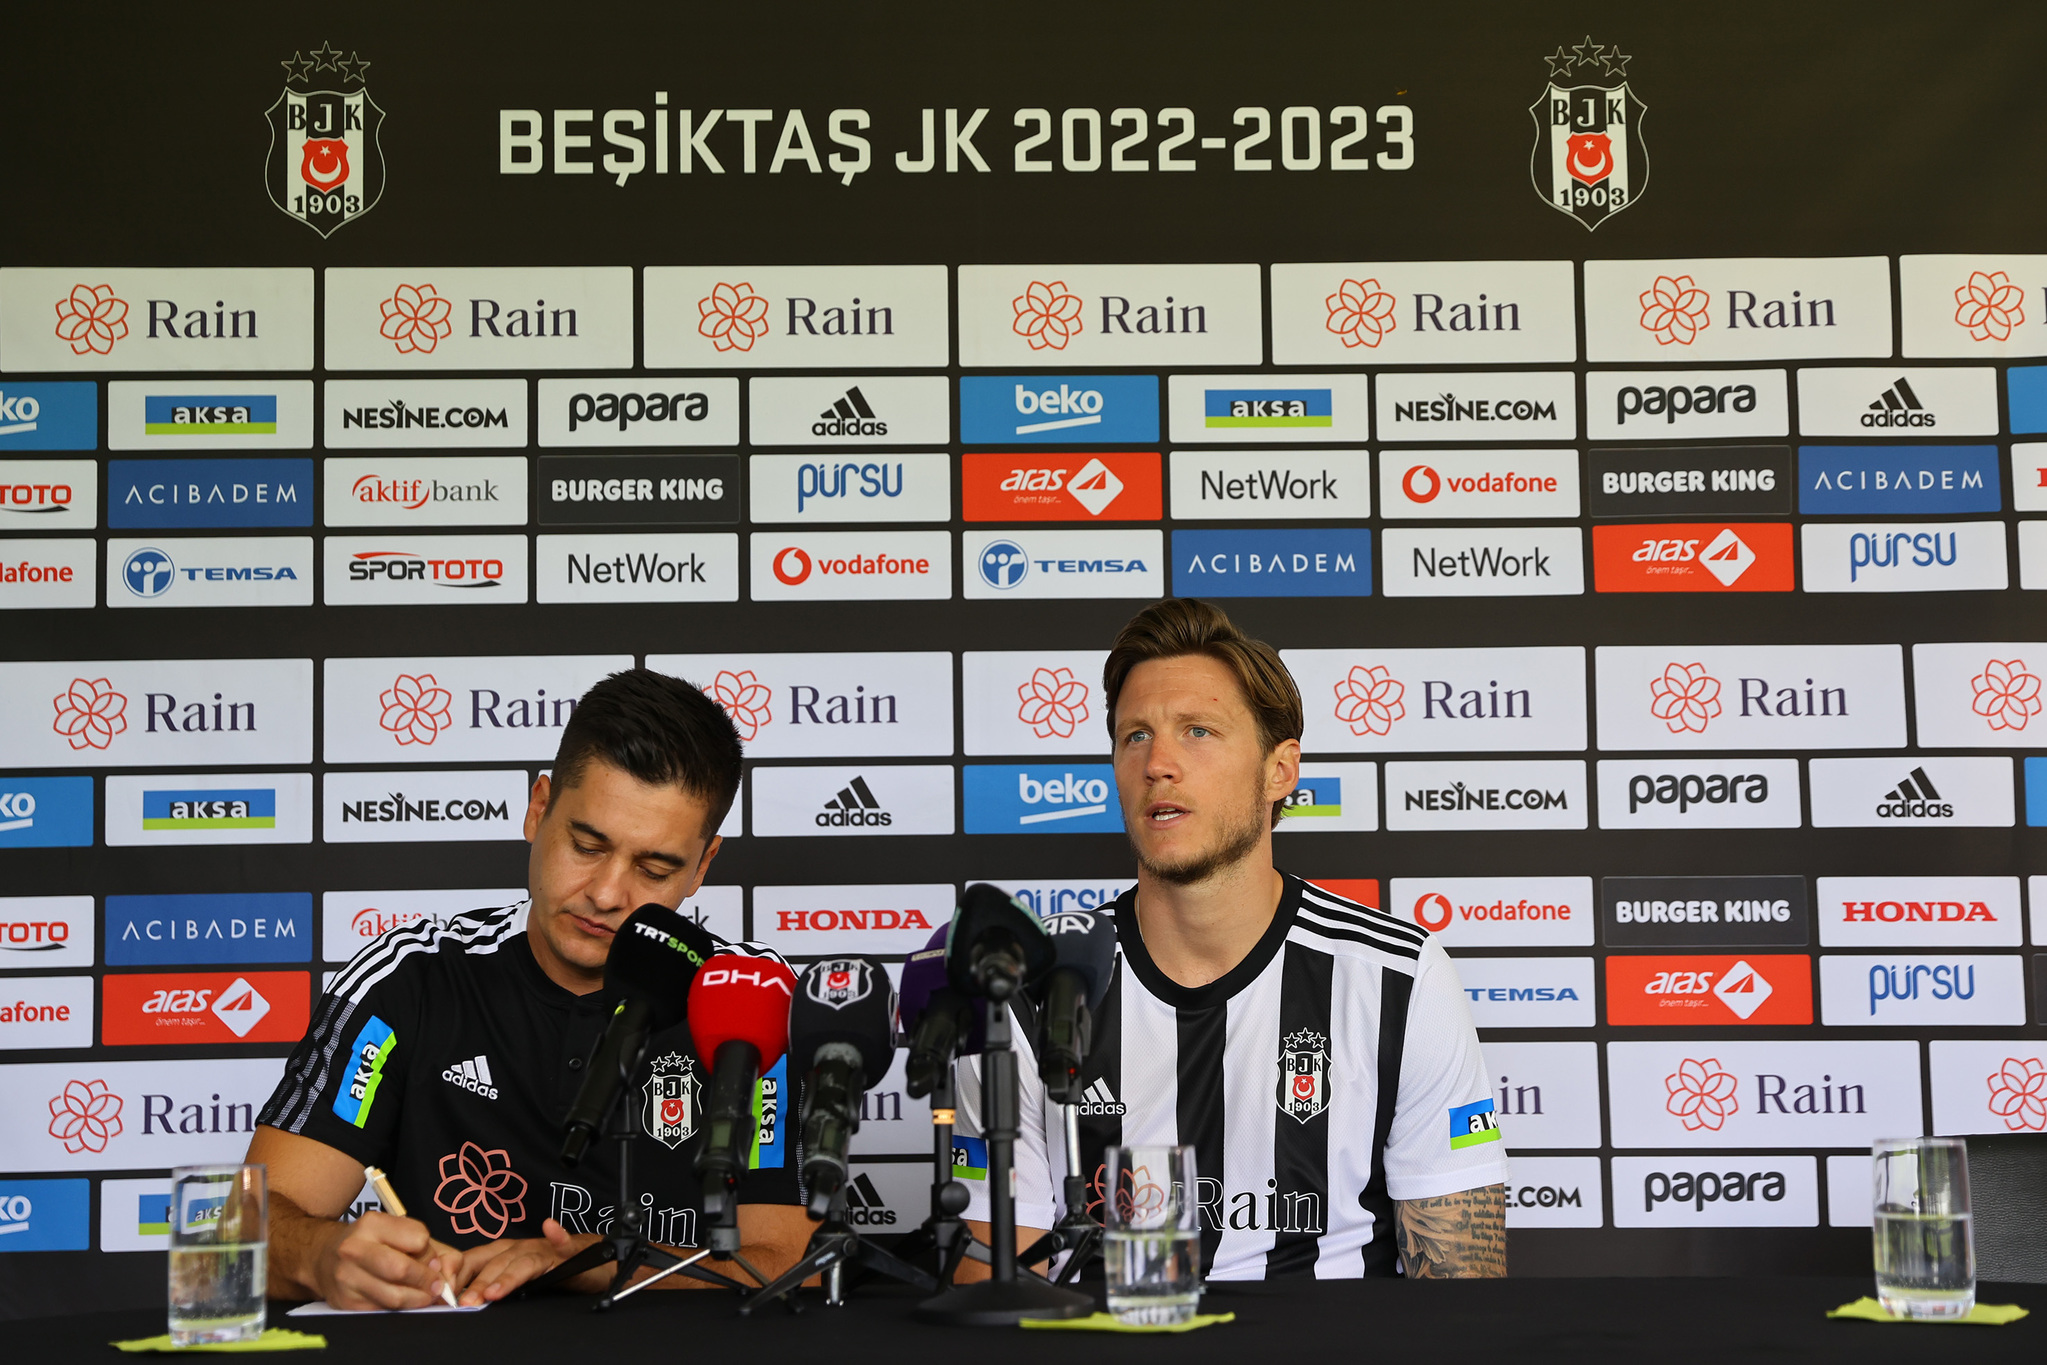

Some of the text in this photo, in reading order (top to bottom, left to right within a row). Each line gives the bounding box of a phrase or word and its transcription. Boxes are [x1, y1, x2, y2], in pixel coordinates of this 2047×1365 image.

[500, 92, 1414, 187] BEŞİKTAŞ JK 2022-2023
[293, 194, 361, 214] 1903
[1559, 186, 1626, 207] 1903
[147, 300, 258, 338] Rain
[470, 300, 578, 337] Rain
[786, 298, 894, 335] Rain
[1100, 296, 1207, 333] Rain
[1413, 294, 1520, 331] Rain
[1727, 291, 1836, 328] Rain
[171, 402, 252, 424] aksa
[569, 393, 708, 432] papara
[1016, 384, 1103, 416] beko
[1230, 396, 1307, 418] aksa
[1617, 385, 1756, 425] papara
[809, 417, 890, 437] adidas
[1858, 410, 1937, 429] adidas
[359, 477, 498, 509] aktif bank
[552, 479, 723, 501] BURGER KING
[1003, 468, 1067, 491] aras
[1202, 470, 1337, 500] NetWork
[1447, 472, 1557, 492] vodafone
[1603, 469, 1775, 493] BURGER KING
[0, 484, 72, 505] TOTO
[818, 554, 929, 574] vodafone
[1414, 547, 1550, 577] NetWork
[1632, 539, 1700, 562] aras
[180, 567, 297, 581] TEMSA
[568, 553, 706, 583] NetWork
[1034, 560, 1147, 573] TEMSA
[469, 689, 579, 728] Rain
[790, 686, 898, 724] Rain
[1423, 680, 1532, 719] Rain
[1739, 678, 1848, 716] Rain
[145, 693, 256, 732] Rain
[1019, 773, 1108, 806] beko
[1629, 774, 1768, 814] papara
[169, 797, 249, 821] aksa
[815, 807, 892, 828] adidas
[1875, 799, 1955, 819] adidas
[776, 909, 932, 931] HONDA
[1459, 900, 1571, 920] vodafone
[1616, 900, 1790, 923] BURGER KING
[1842, 901, 1997, 922] HONDA
[0, 921, 69, 943] TOTO
[702, 969, 792, 996] DHA
[1464, 988, 1579, 1001] TEMSA
[1644, 971, 1714, 994] aras
[0, 1001, 70, 1022] afone
[140, 987, 212, 1014] aras
[442, 1069, 498, 1100] adidas
[1756, 1075, 1866, 1114] Rain
[140, 1093, 254, 1134] Rain
[759, 1079, 778, 1144] aksa
[1288, 1101, 1320, 1112] 1903
[656, 1127, 690, 1138] 1903
[1196, 1177, 1323, 1233] Rain
[1645, 1172, 1785, 1212] papara
